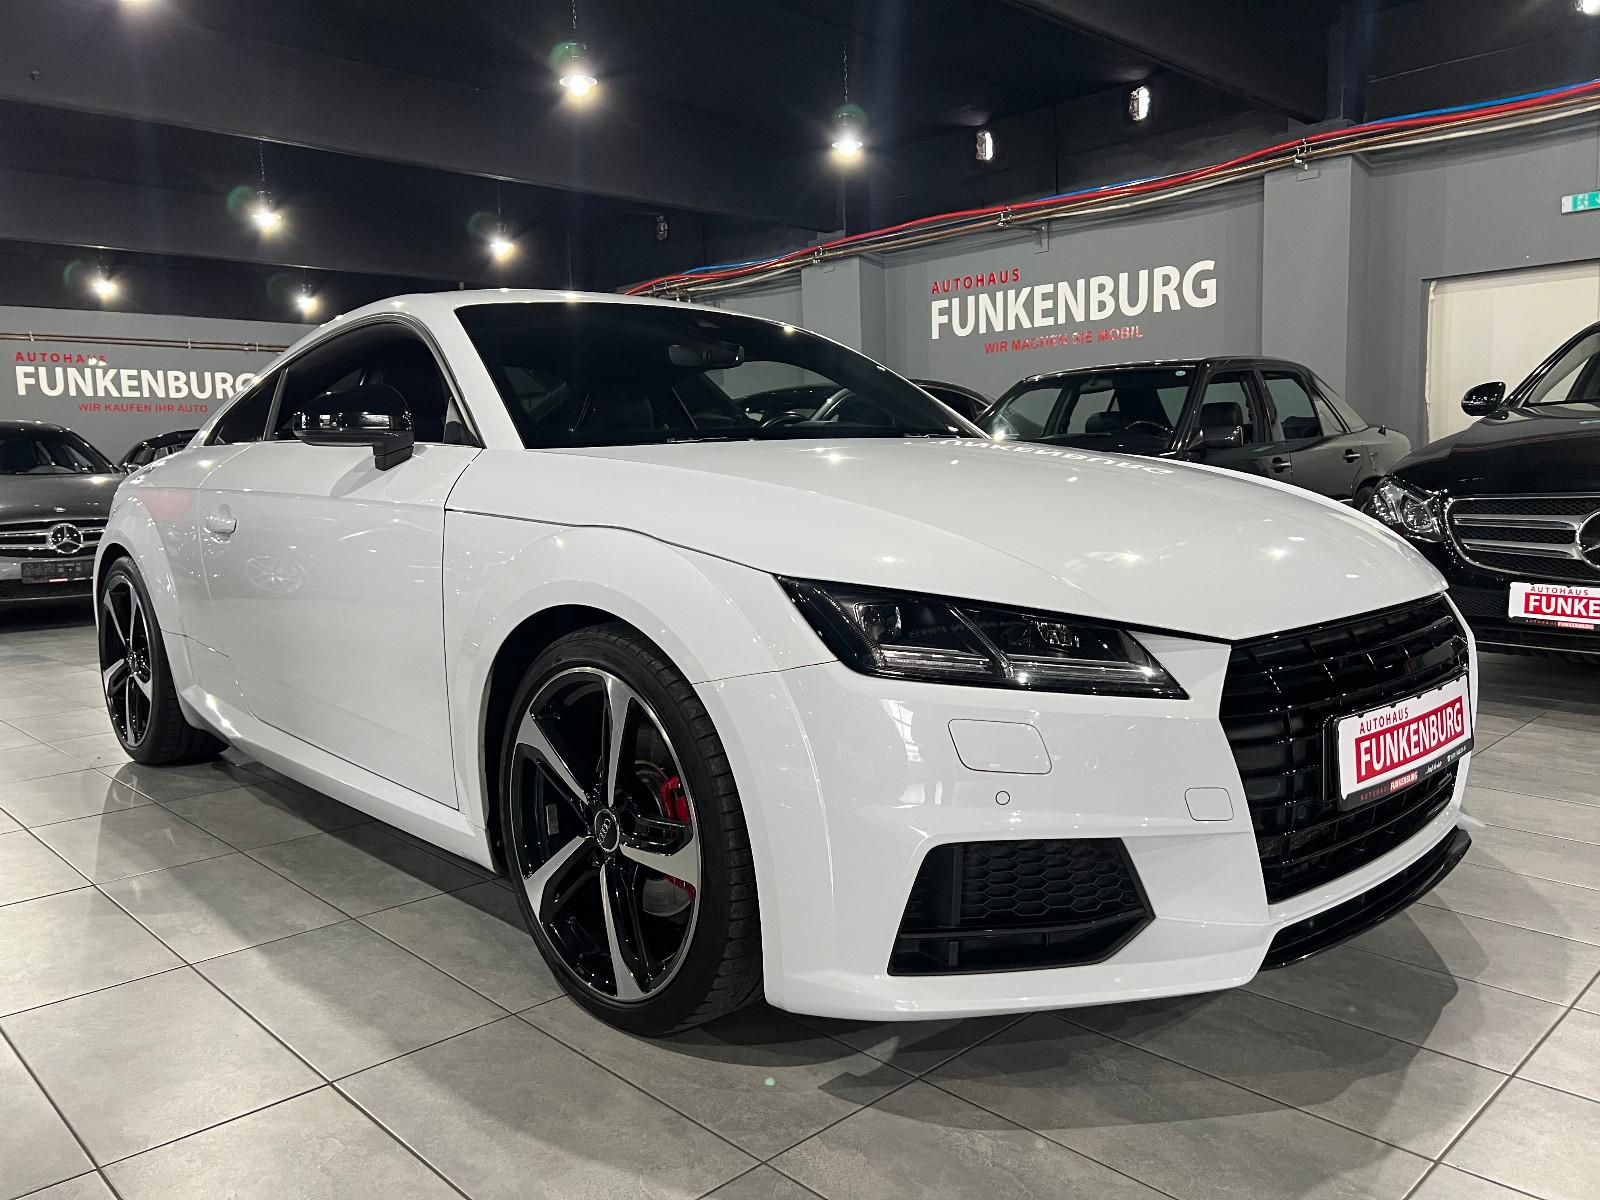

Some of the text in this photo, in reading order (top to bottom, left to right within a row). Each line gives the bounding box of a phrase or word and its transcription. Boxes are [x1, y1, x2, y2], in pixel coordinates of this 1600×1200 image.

[931, 268, 1021, 294] AUTOHAUS
[930, 259, 1217, 340] FUNKENBURG
[984, 325, 1143, 354] WIR MACHEN SIE MOBIL
[79, 402, 208, 414] WIR KAUFEN IHR AUTO
[1530, 586, 1589, 596] AUTOHAUS
[1359, 707, 1409, 735] AUTOHAUS
[1359, 702, 1462, 776] FUNKENBURG
